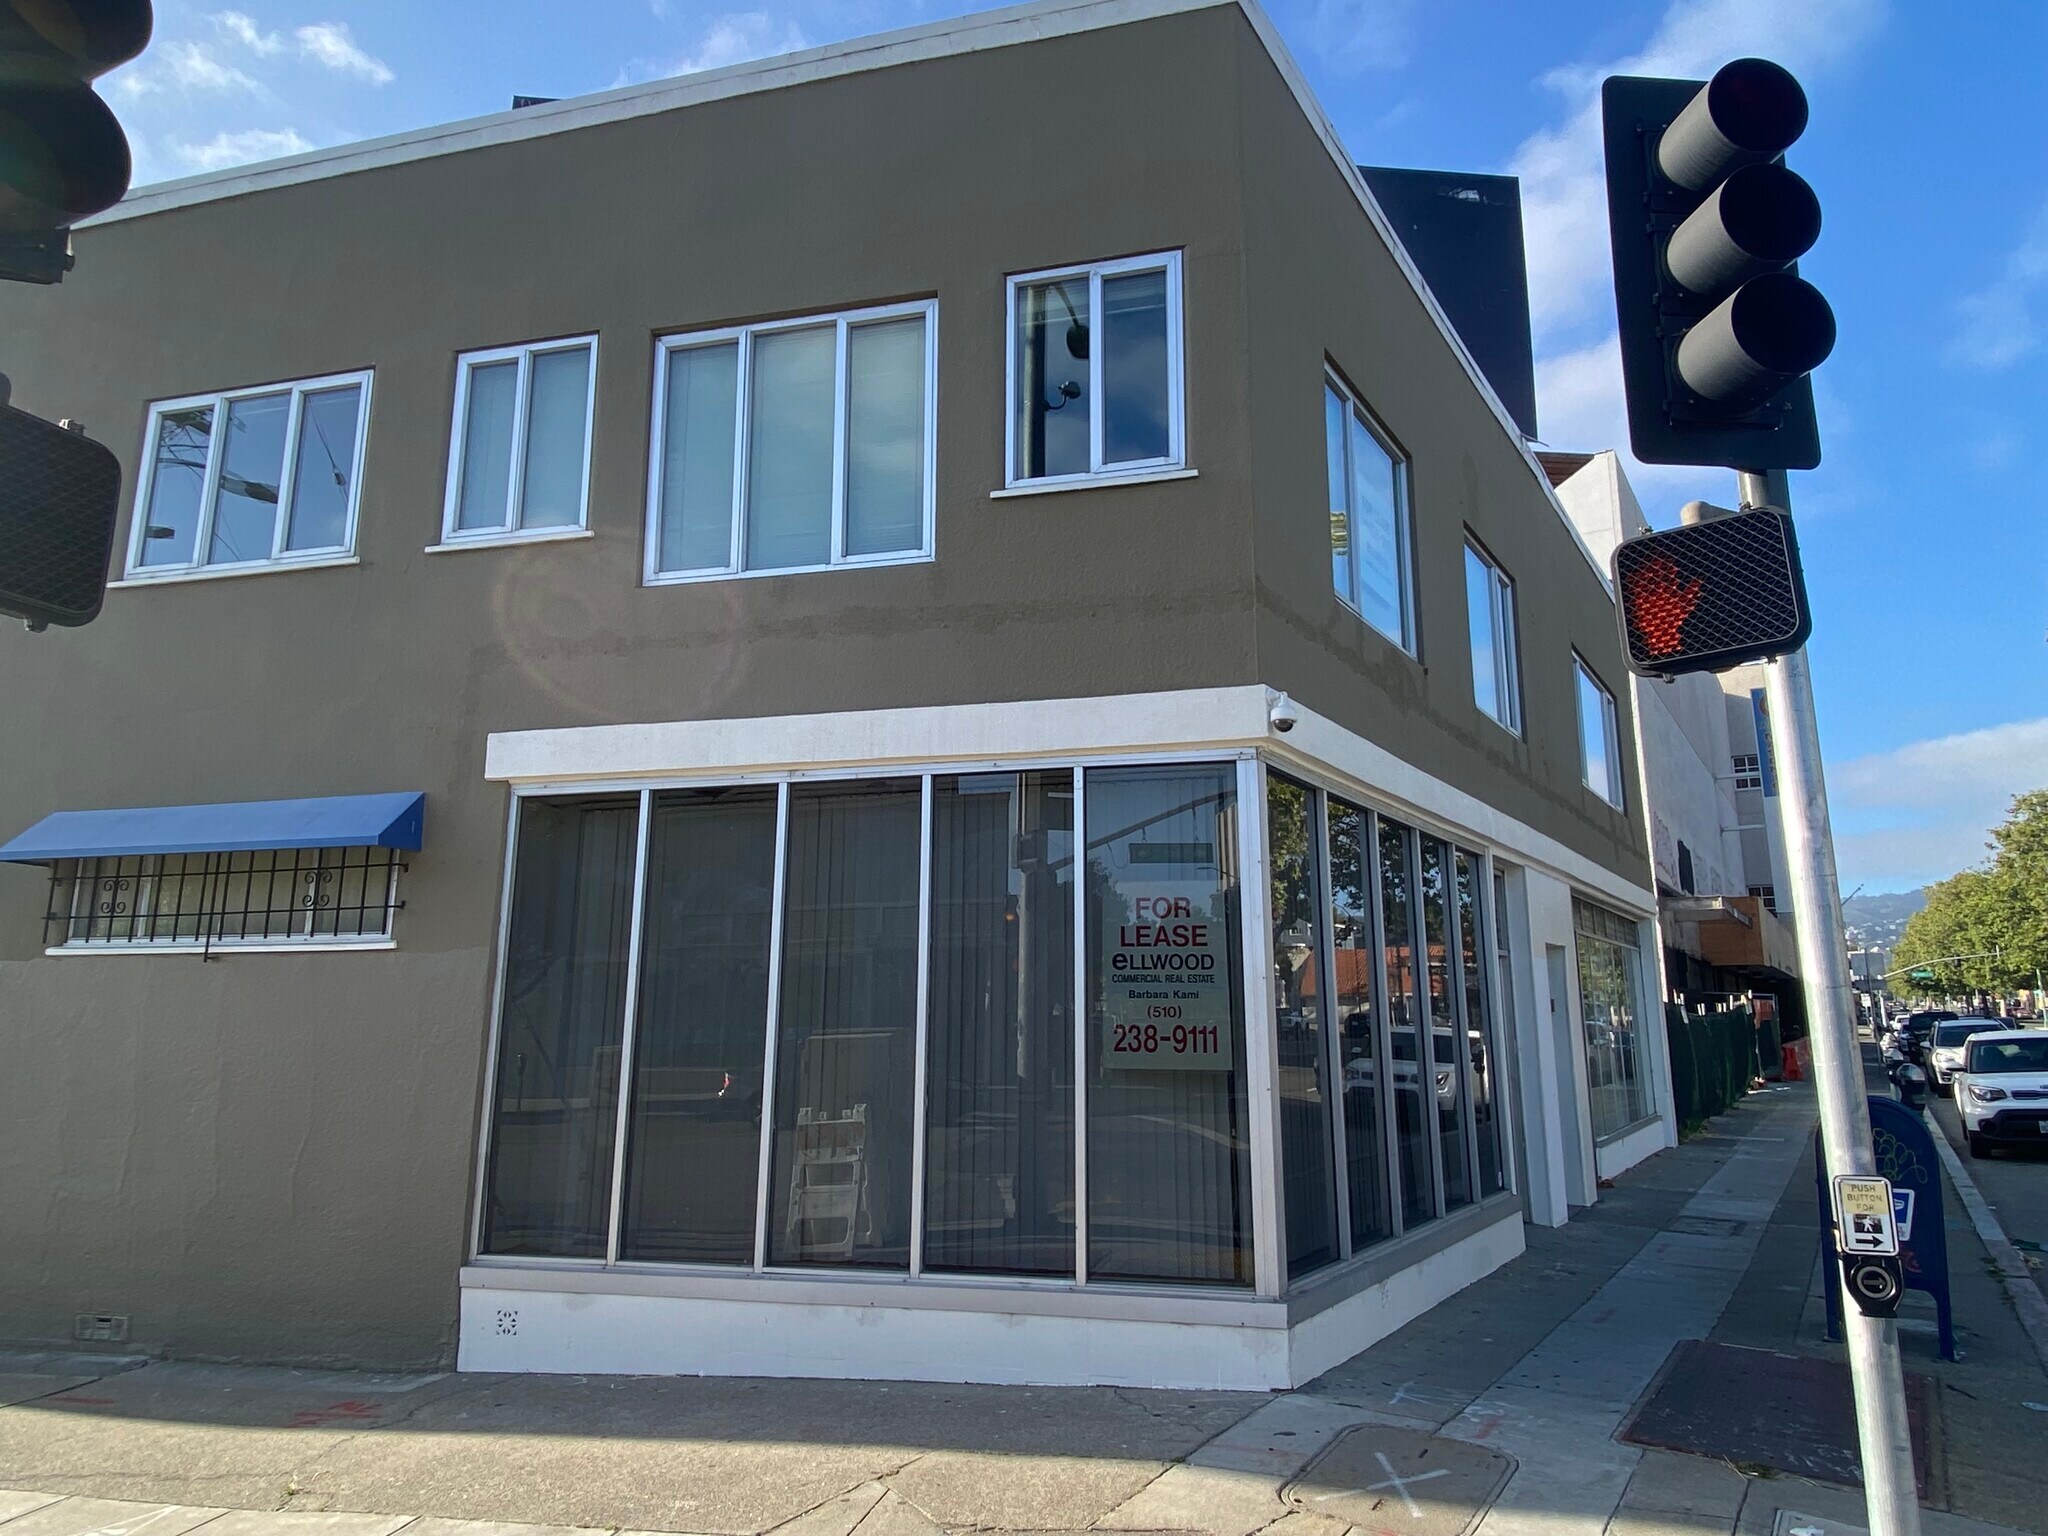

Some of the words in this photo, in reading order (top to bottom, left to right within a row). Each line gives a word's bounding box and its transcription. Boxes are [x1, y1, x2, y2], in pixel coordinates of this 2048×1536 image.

[1135, 897, 1191, 920] FOR
[1120, 925, 1208, 948] LEASE
[1112, 973, 1162, 984] COMMERCIAL
[1165, 973, 1184, 984] REAL
[1187, 973, 1215, 984] ESTATE
[1128, 989, 1169, 999] Barbara
[1173, 989, 1200, 999] Kami
[1147, 1005, 1182, 1019] (510)
[1113, 1024, 1219, 1054] 238-9111
[1851, 1183, 1876, 1192] PUSH
[1846, 1193, 1882, 1202] BUTTON
[1856, 1203, 1875, 1211] FOR
